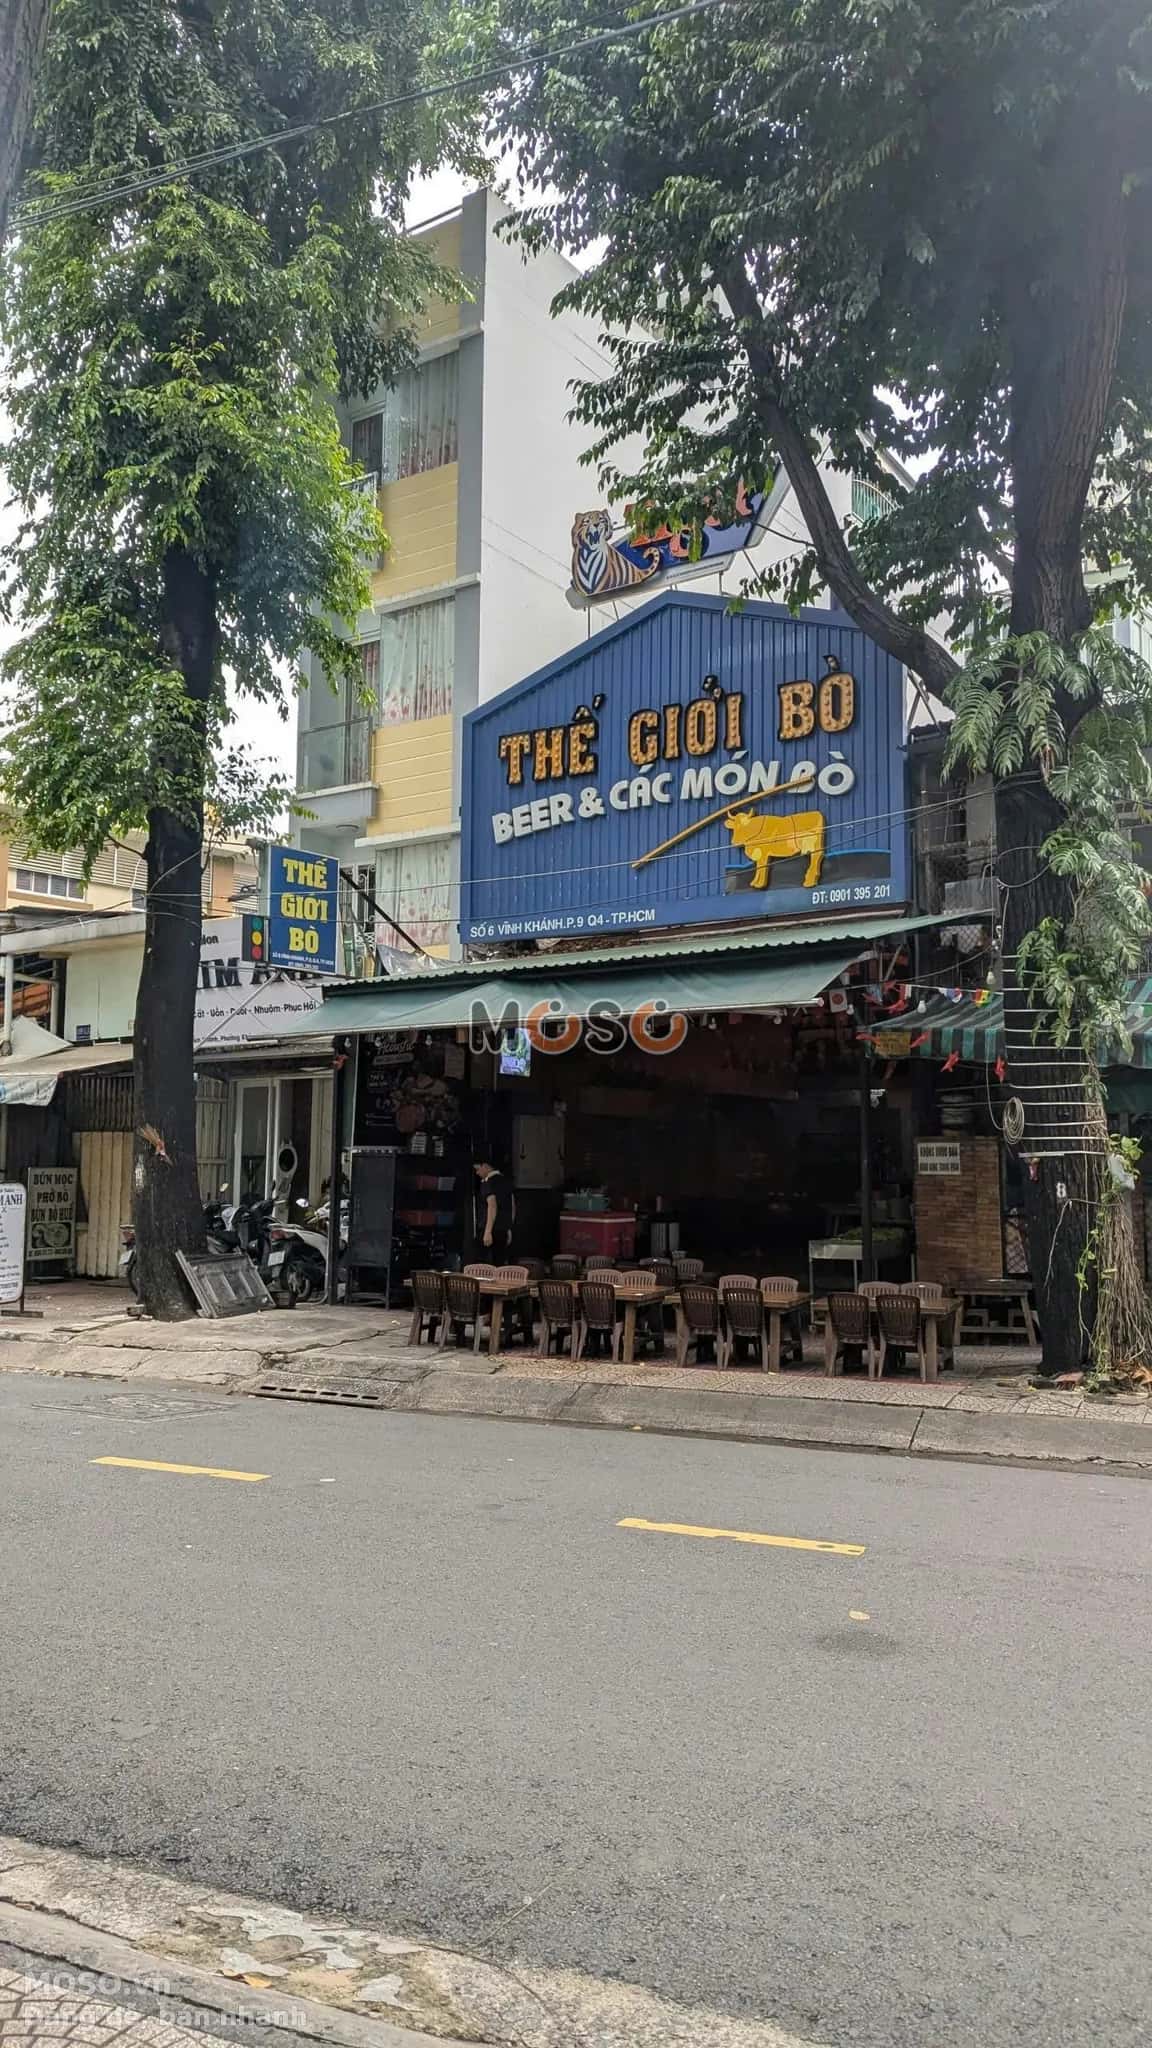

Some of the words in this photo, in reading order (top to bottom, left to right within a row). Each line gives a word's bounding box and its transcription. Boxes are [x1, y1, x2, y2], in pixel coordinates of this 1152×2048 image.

[498, 693, 605, 785] THẾ
[777, 654, 856, 742] BÒ
[492, 792, 574, 845] BEER
[577, 787, 606, 819] &
[609, 763, 673, 811] CÁC
[680, 751, 780, 800] MÓN
[787, 751, 856, 797] BÒ
[283, 858, 328, 890] THẾ
[280, 893, 329, 924] GIỚI
[830, 888, 850, 902] 0901
[854, 887, 871, 900] 395
[874, 884, 890, 898] 201
[289, 926, 320, 956] BÒ
[470, 921, 486, 937] SỐ
[488, 926, 494, 936] 6
[498, 921, 522, 935] VĨNH
